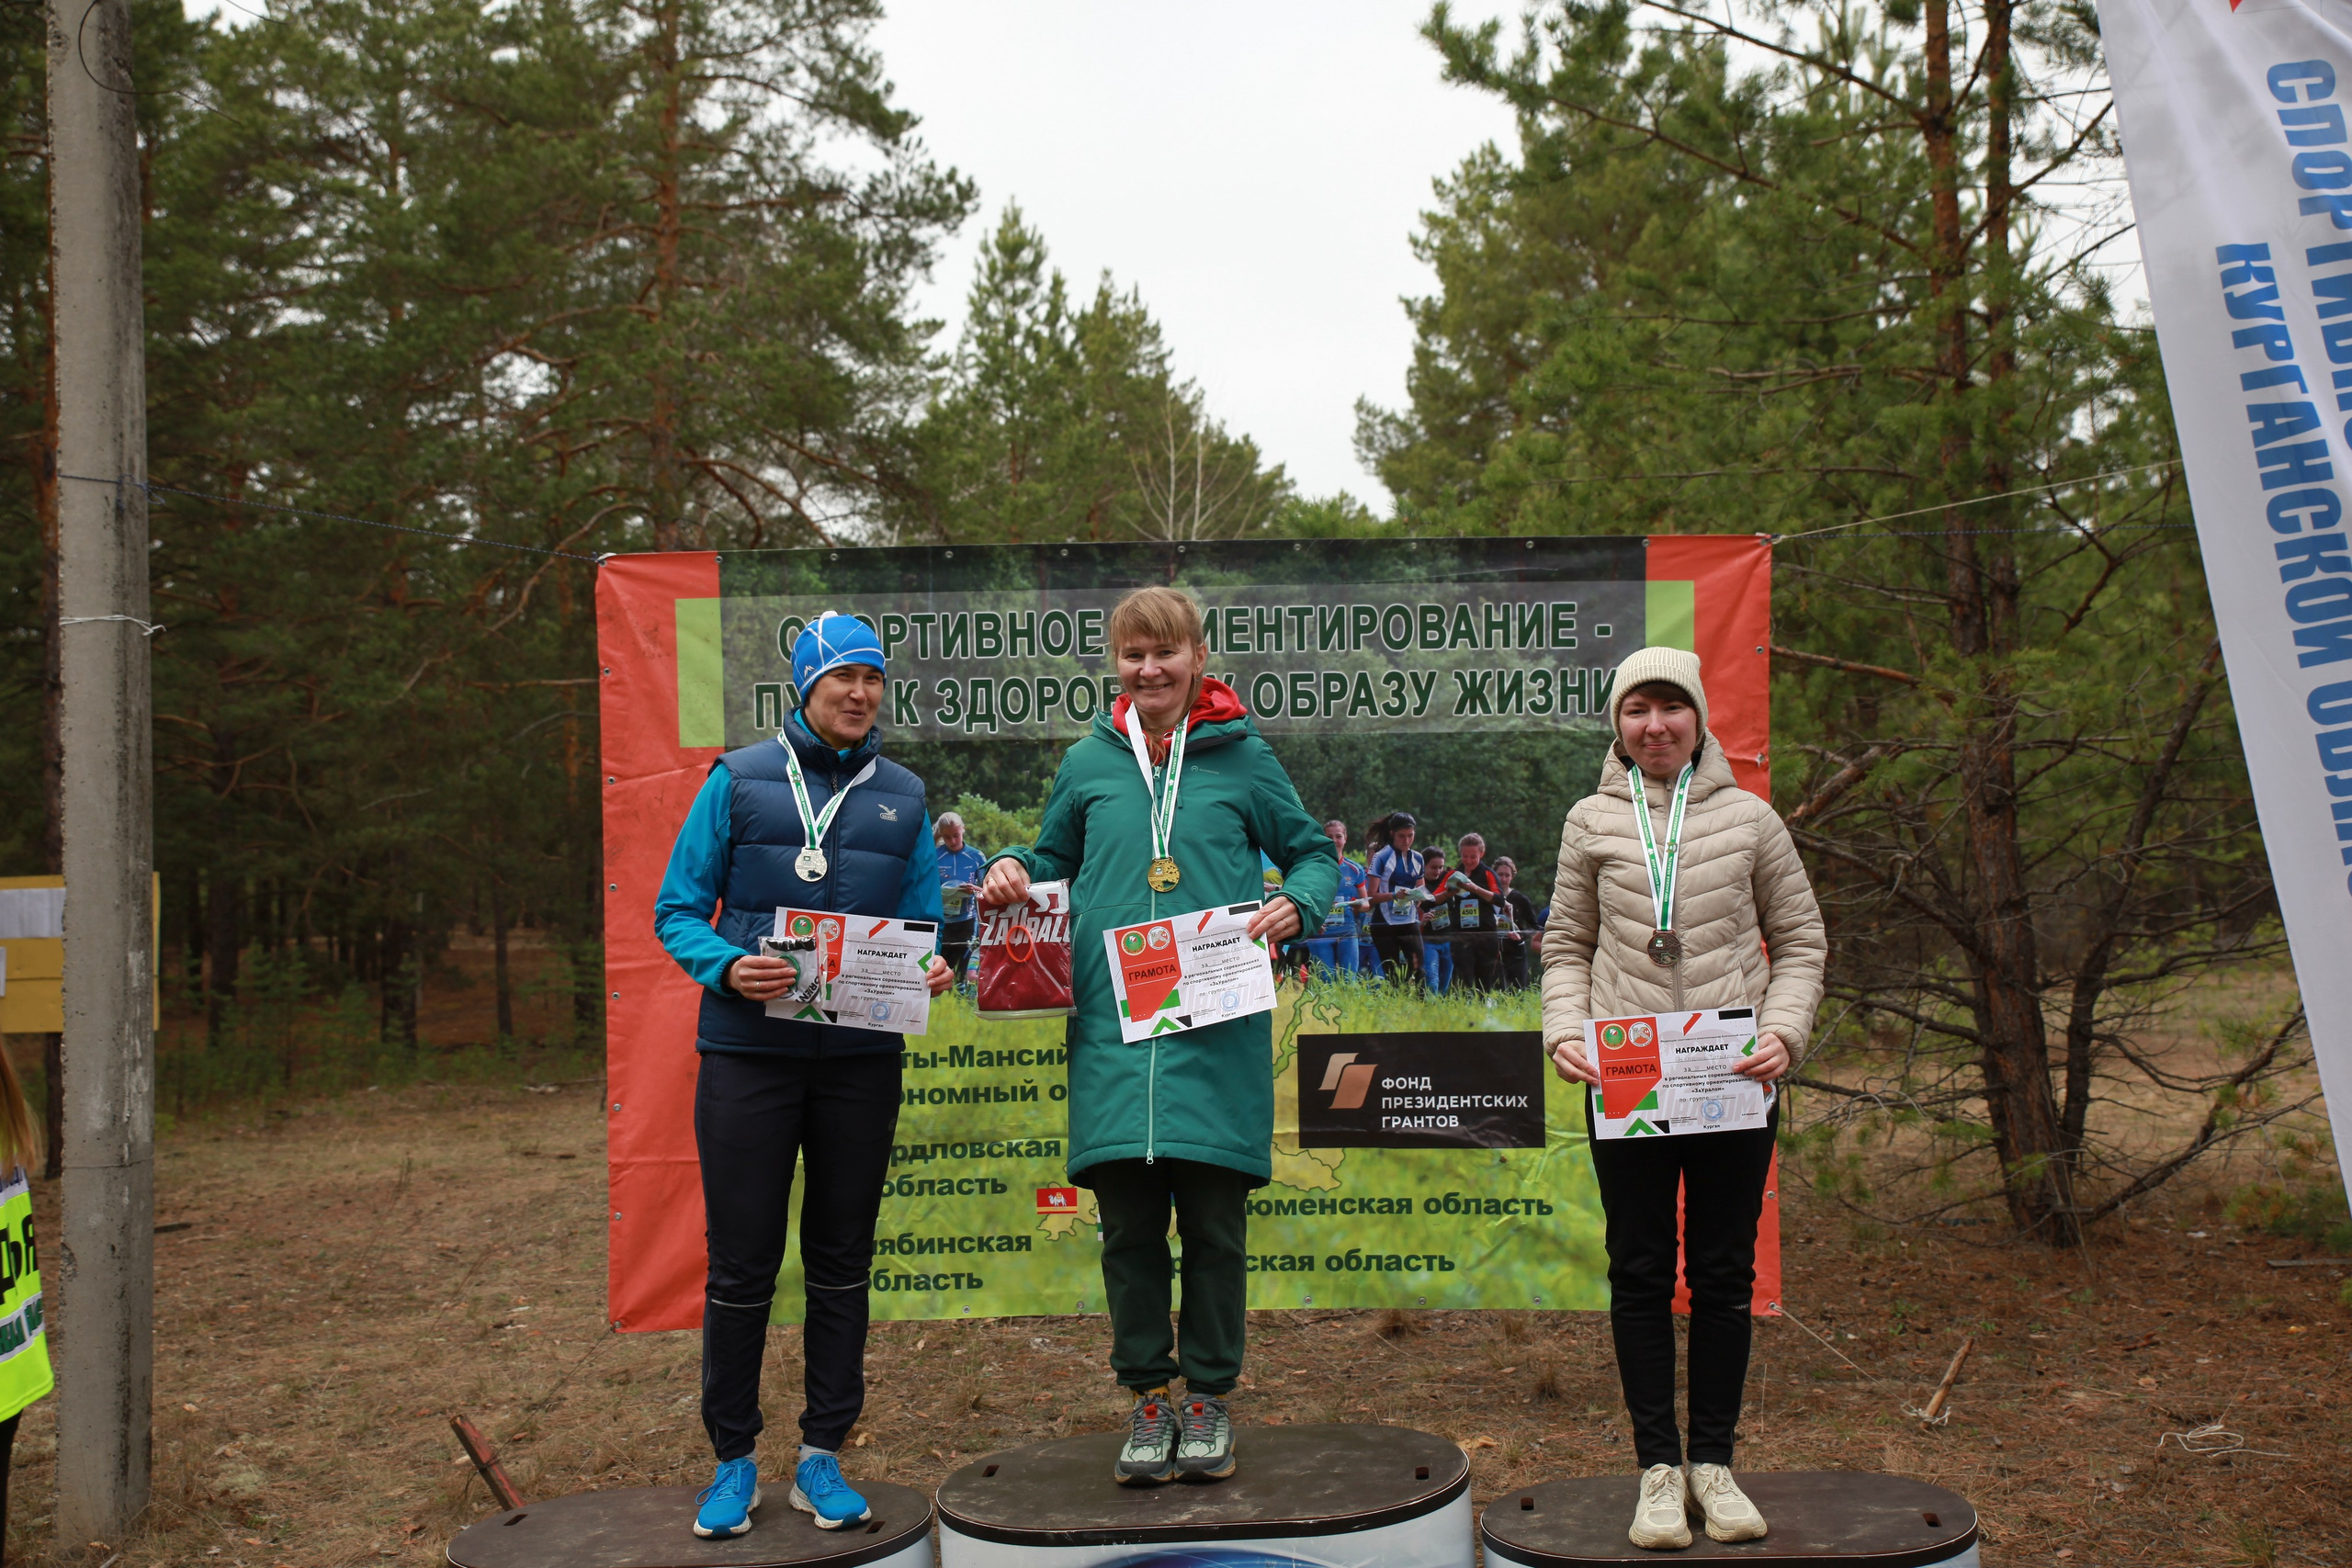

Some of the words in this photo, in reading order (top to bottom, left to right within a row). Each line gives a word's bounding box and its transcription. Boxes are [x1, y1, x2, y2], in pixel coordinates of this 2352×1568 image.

[779, 610, 1103, 660] СРТИВНОЕ
[1201, 603, 1577, 653] ИЕНТИРОВАНИЕ
[894, 681, 920, 725] К
[1251, 671, 1438, 718] ОБРАЗУ
[1453, 668, 1617, 716] ЖИЗНИ
[1192, 936, 1241, 952] НАГРАЖДАЕТ
[857, 948, 908, 960] НАГРАЖДАЕТ
[1128, 964, 1177, 981] ГРАМОТА
[1675, 1043, 1729, 1054] НАГРАЖДАЕТ
[1605, 1064, 1657, 1077] ГРАМОТА
[1381, 1077, 1432, 1090] ФОНД
[1382, 1095, 1529, 1110] ПРЕЗИДЕНТСКИХ
[1382, 1115, 1460, 1128] ГРАНТОВ
[890, 1140, 1061, 1167] рдловская
[881, 1174, 1008, 1198] область
[1247, 1197, 1413, 1216] юменская
[1423, 1192, 1554, 1215] область
[1325, 1248, 1455, 1271] область
[868, 1269, 983, 1292] бласть
